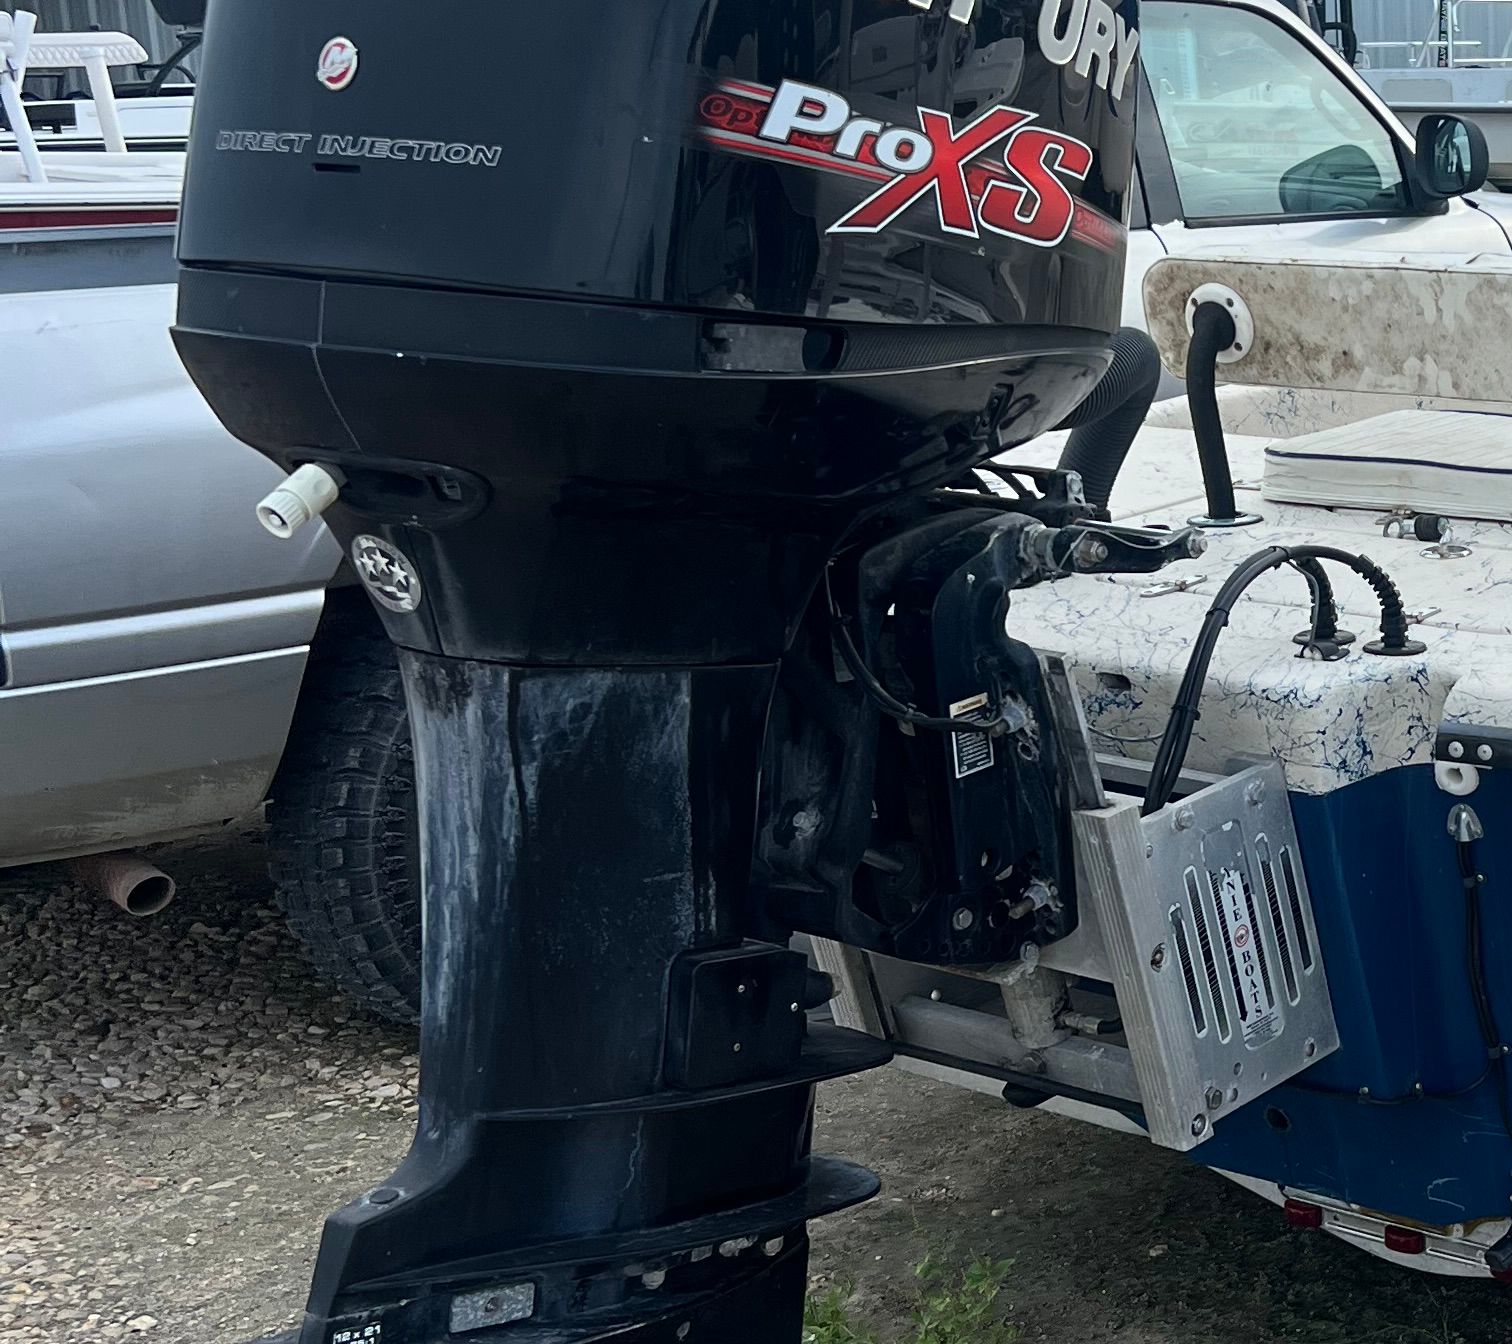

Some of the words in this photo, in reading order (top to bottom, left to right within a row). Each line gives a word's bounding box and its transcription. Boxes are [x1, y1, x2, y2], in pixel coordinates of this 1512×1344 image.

[215, 129, 312, 153] DIRECT
[317, 134, 502, 167] INJECTION
[1241, 950, 1263, 1019] BOATS
[335, 1331, 351, 1343] 12
[364, 1324, 381, 1337] 21
